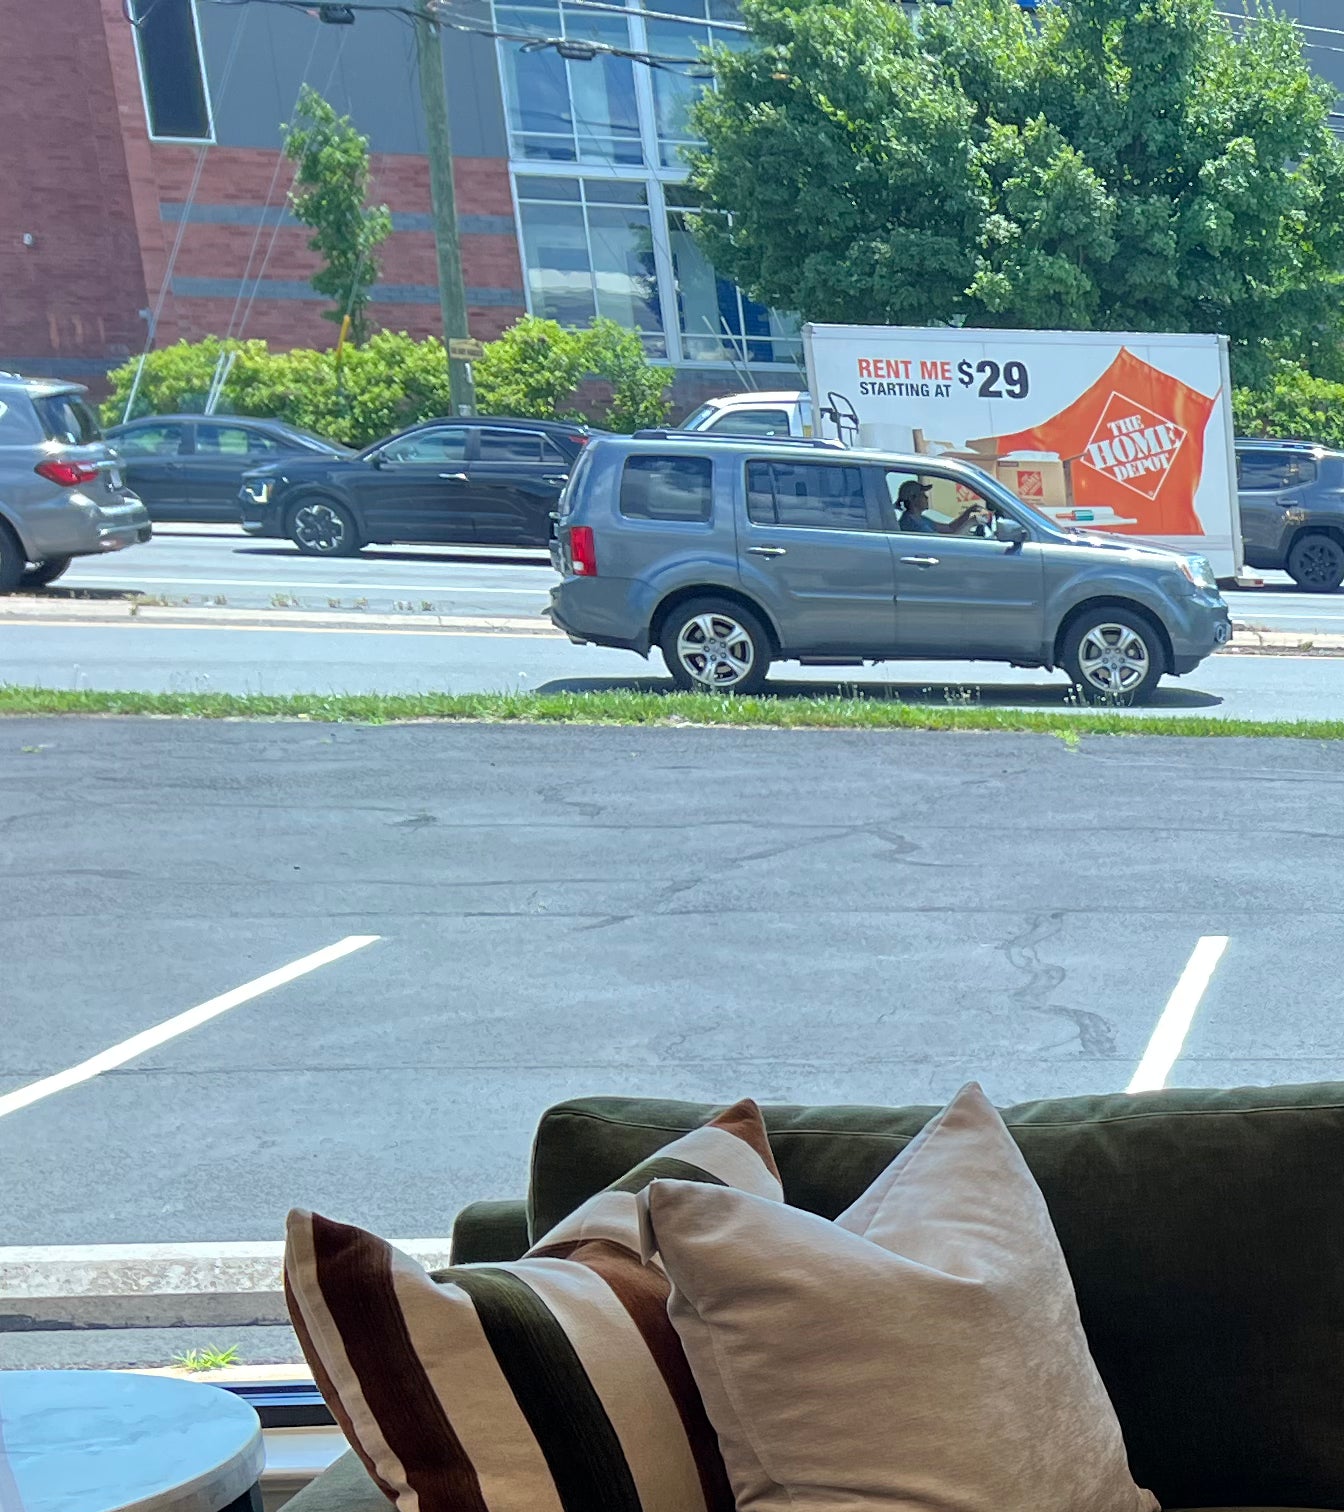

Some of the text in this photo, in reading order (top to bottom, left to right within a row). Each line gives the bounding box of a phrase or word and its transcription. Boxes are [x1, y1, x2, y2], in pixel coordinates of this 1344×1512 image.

[857, 358, 953, 381] RENT ME
[957, 358, 1030, 399] $29
[860, 381, 952, 398] STARTING AT
[1106, 414, 1145, 436] THE
[1088, 421, 1181, 470] HOME
[1112, 453, 1170, 481] DEPOT
